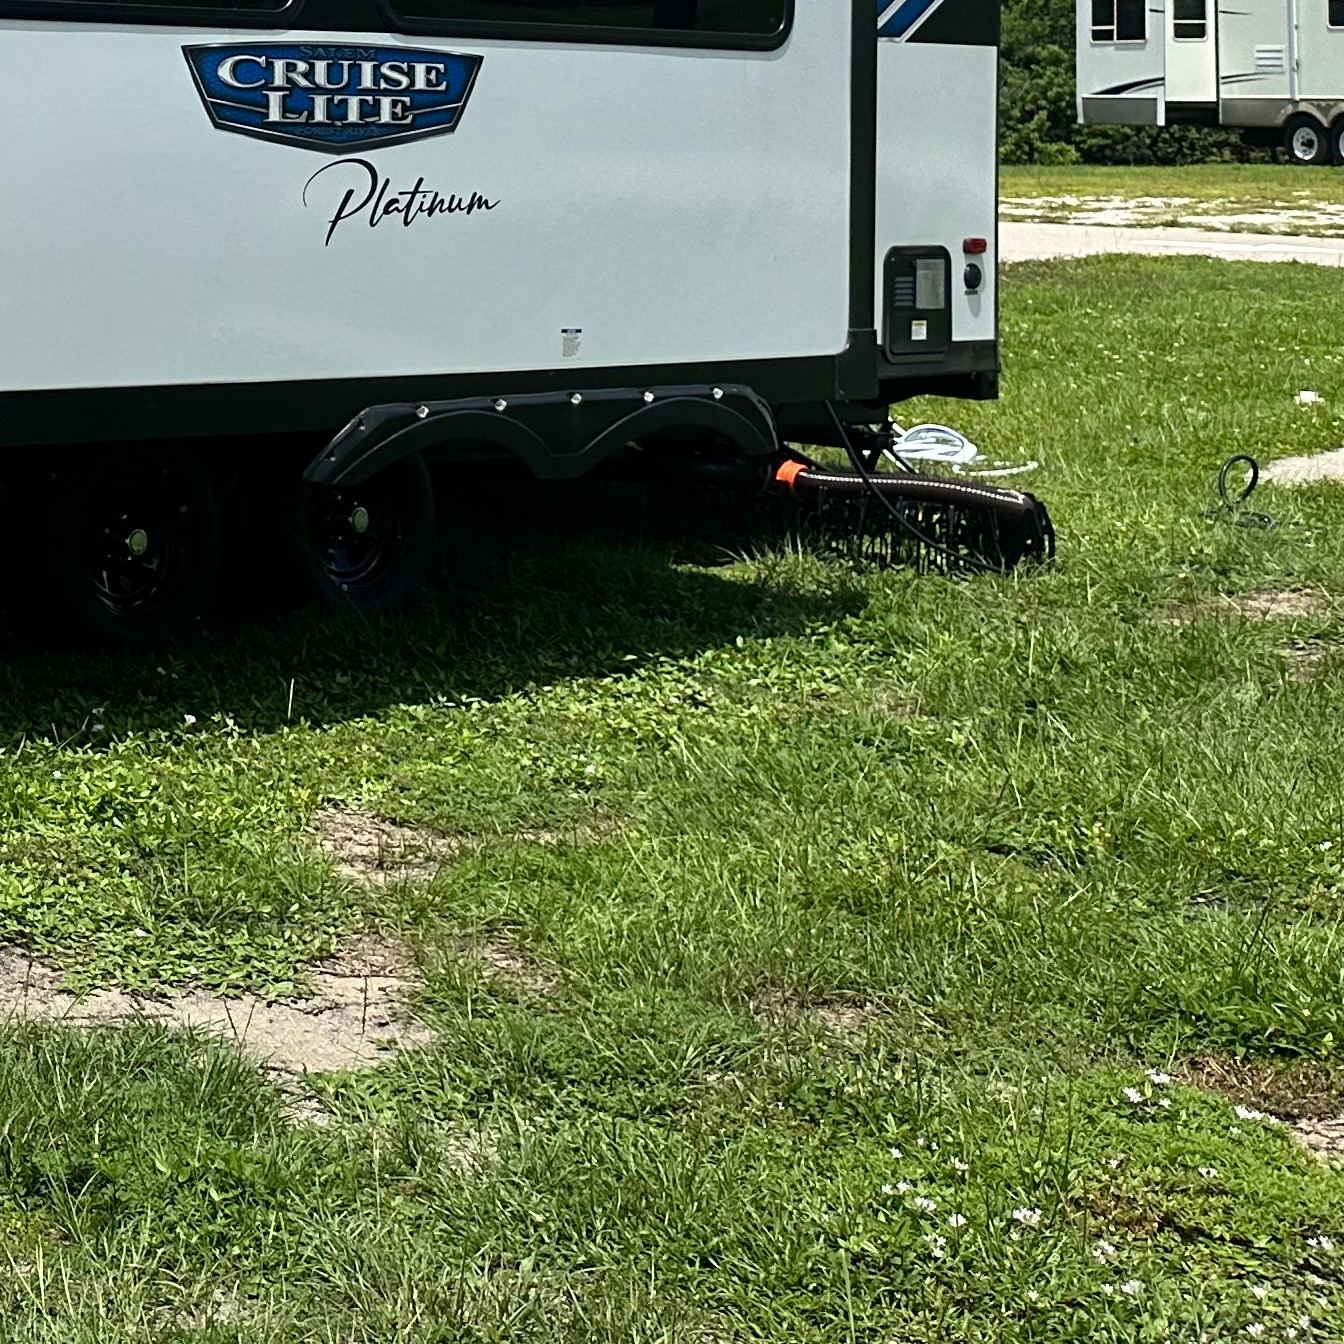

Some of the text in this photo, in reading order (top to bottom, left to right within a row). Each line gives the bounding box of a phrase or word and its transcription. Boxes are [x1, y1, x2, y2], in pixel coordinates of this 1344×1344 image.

[299, 45, 377, 61] SALEM
[216, 54, 448, 92] CRUISE
[261, 89, 415, 127] LITE
[301, 157, 501, 247] Platinum
